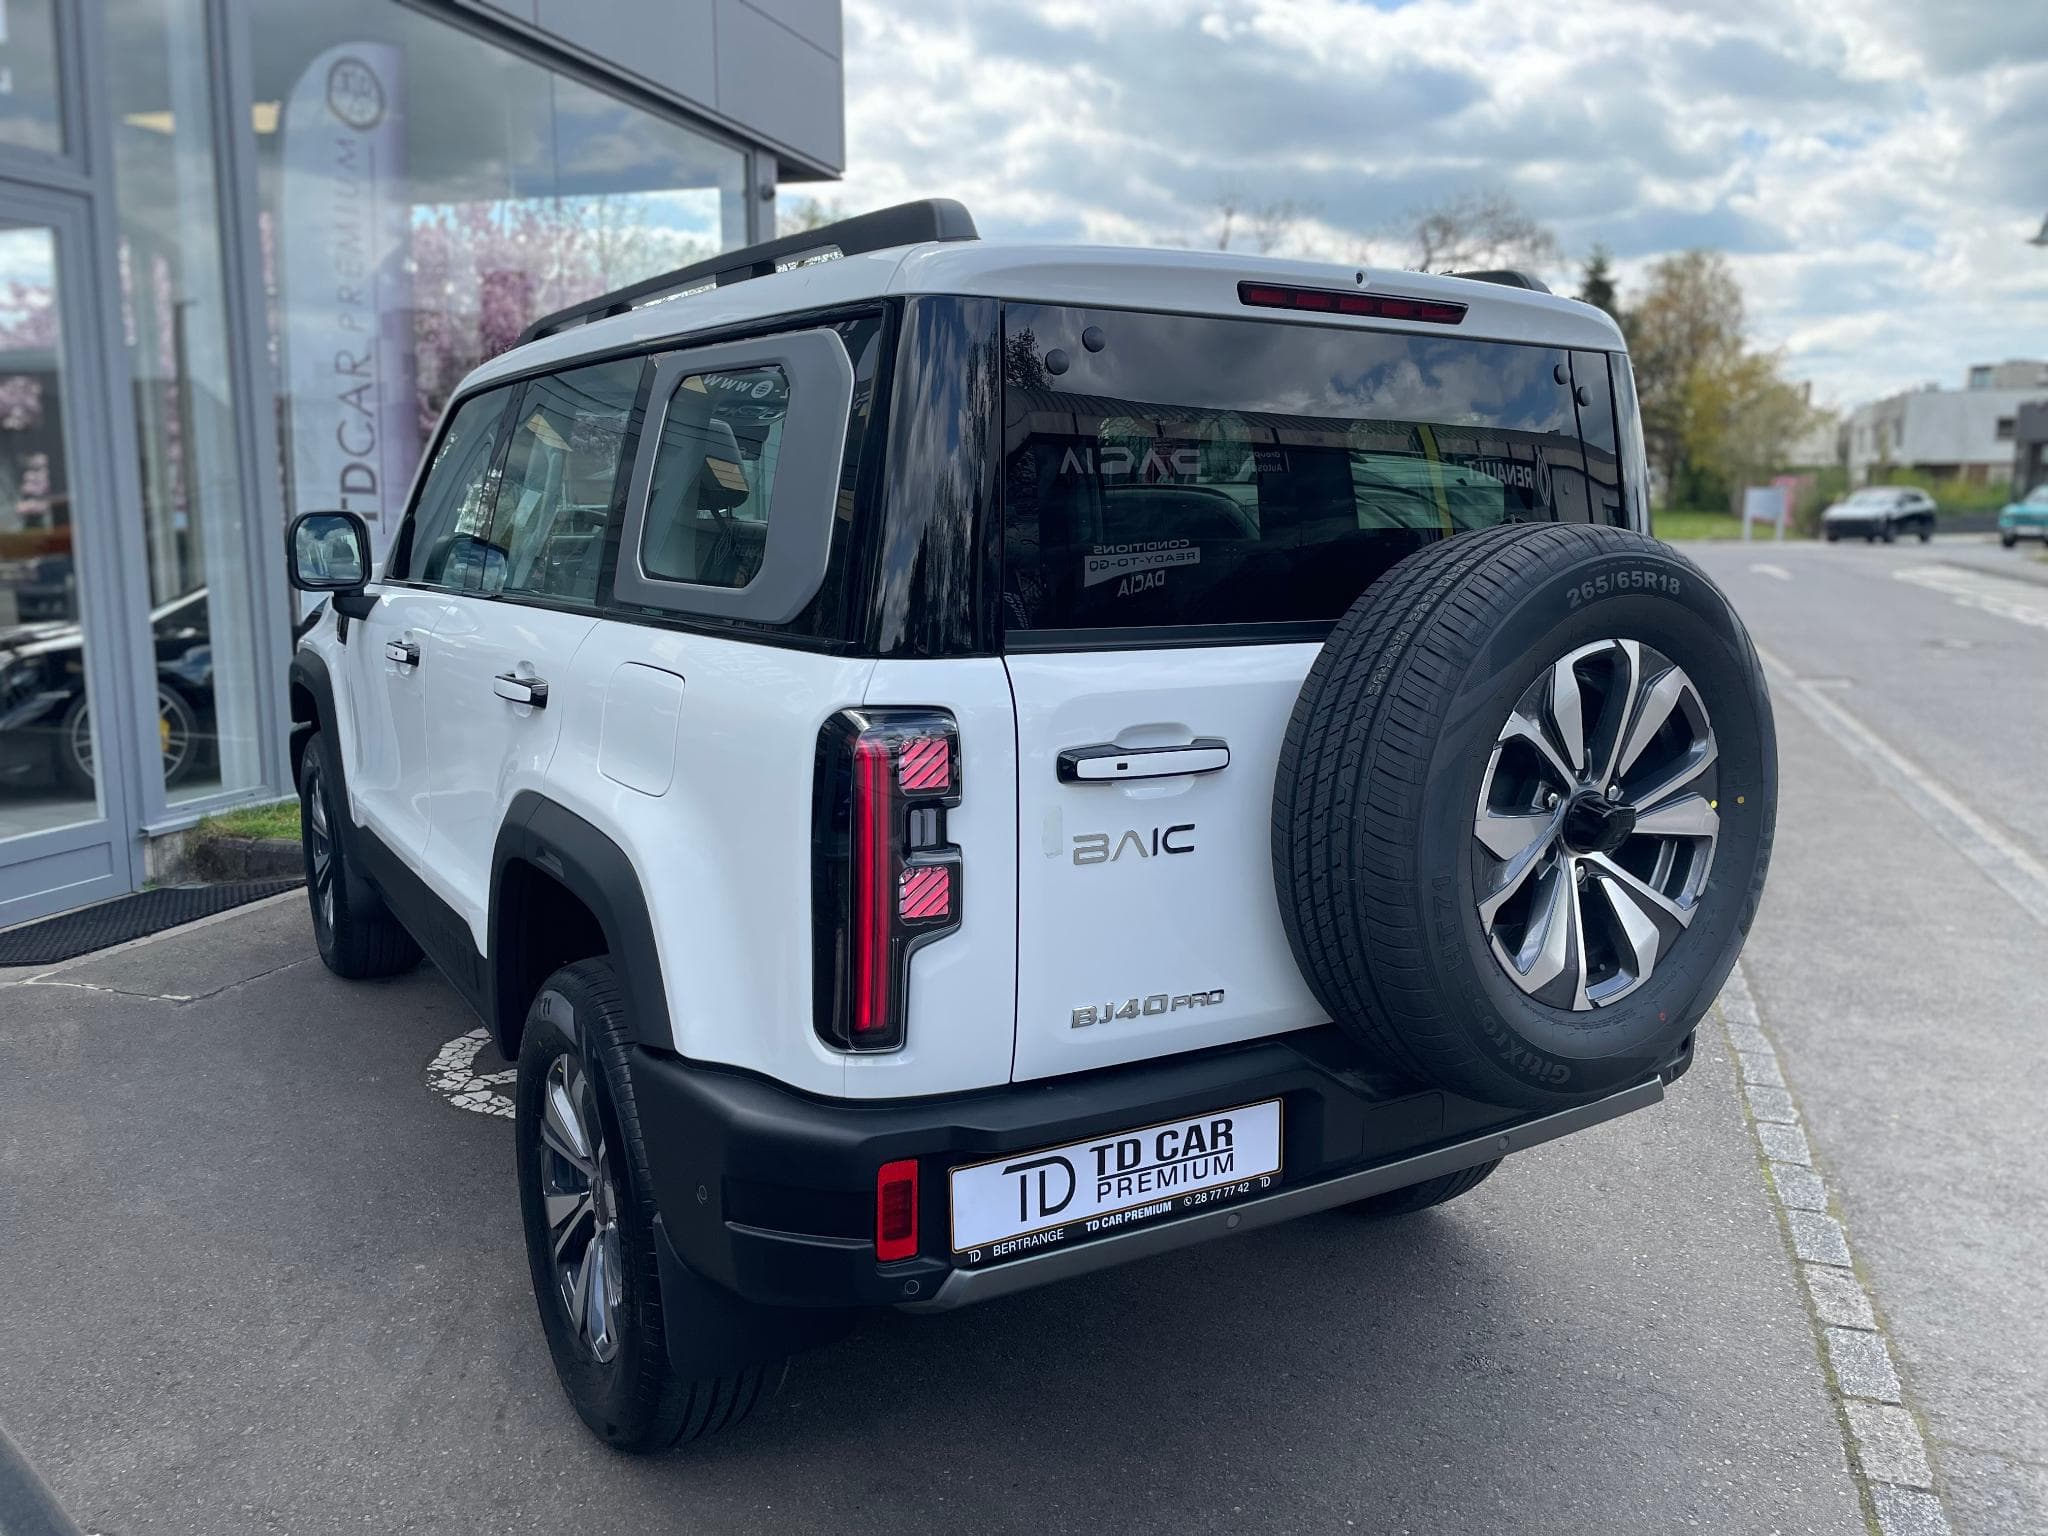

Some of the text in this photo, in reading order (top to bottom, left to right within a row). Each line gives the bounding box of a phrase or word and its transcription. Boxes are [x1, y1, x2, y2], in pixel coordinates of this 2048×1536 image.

[333, 138, 365, 332] PREMIUM
[1566, 570, 1681, 609] 265/65R18
[1073, 823, 1196, 866] BAIC
[1089, 1118, 1234, 1177] TD CAR
[1097, 1152, 1234, 1203] PREMIUM
[993, 1228, 1065, 1257] BERTRANGE
[1085, 1219, 1100, 1233] TD
[1101, 1212, 1123, 1229] CAR
[1124, 1200, 1172, 1223] PREMIUM
[1194, 1191, 1208, 1205] 28
[1209, 1187, 1222, 1202] 77
[1223, 1184, 1235, 1199] 77
[1237, 1181, 1250, 1194] 42
